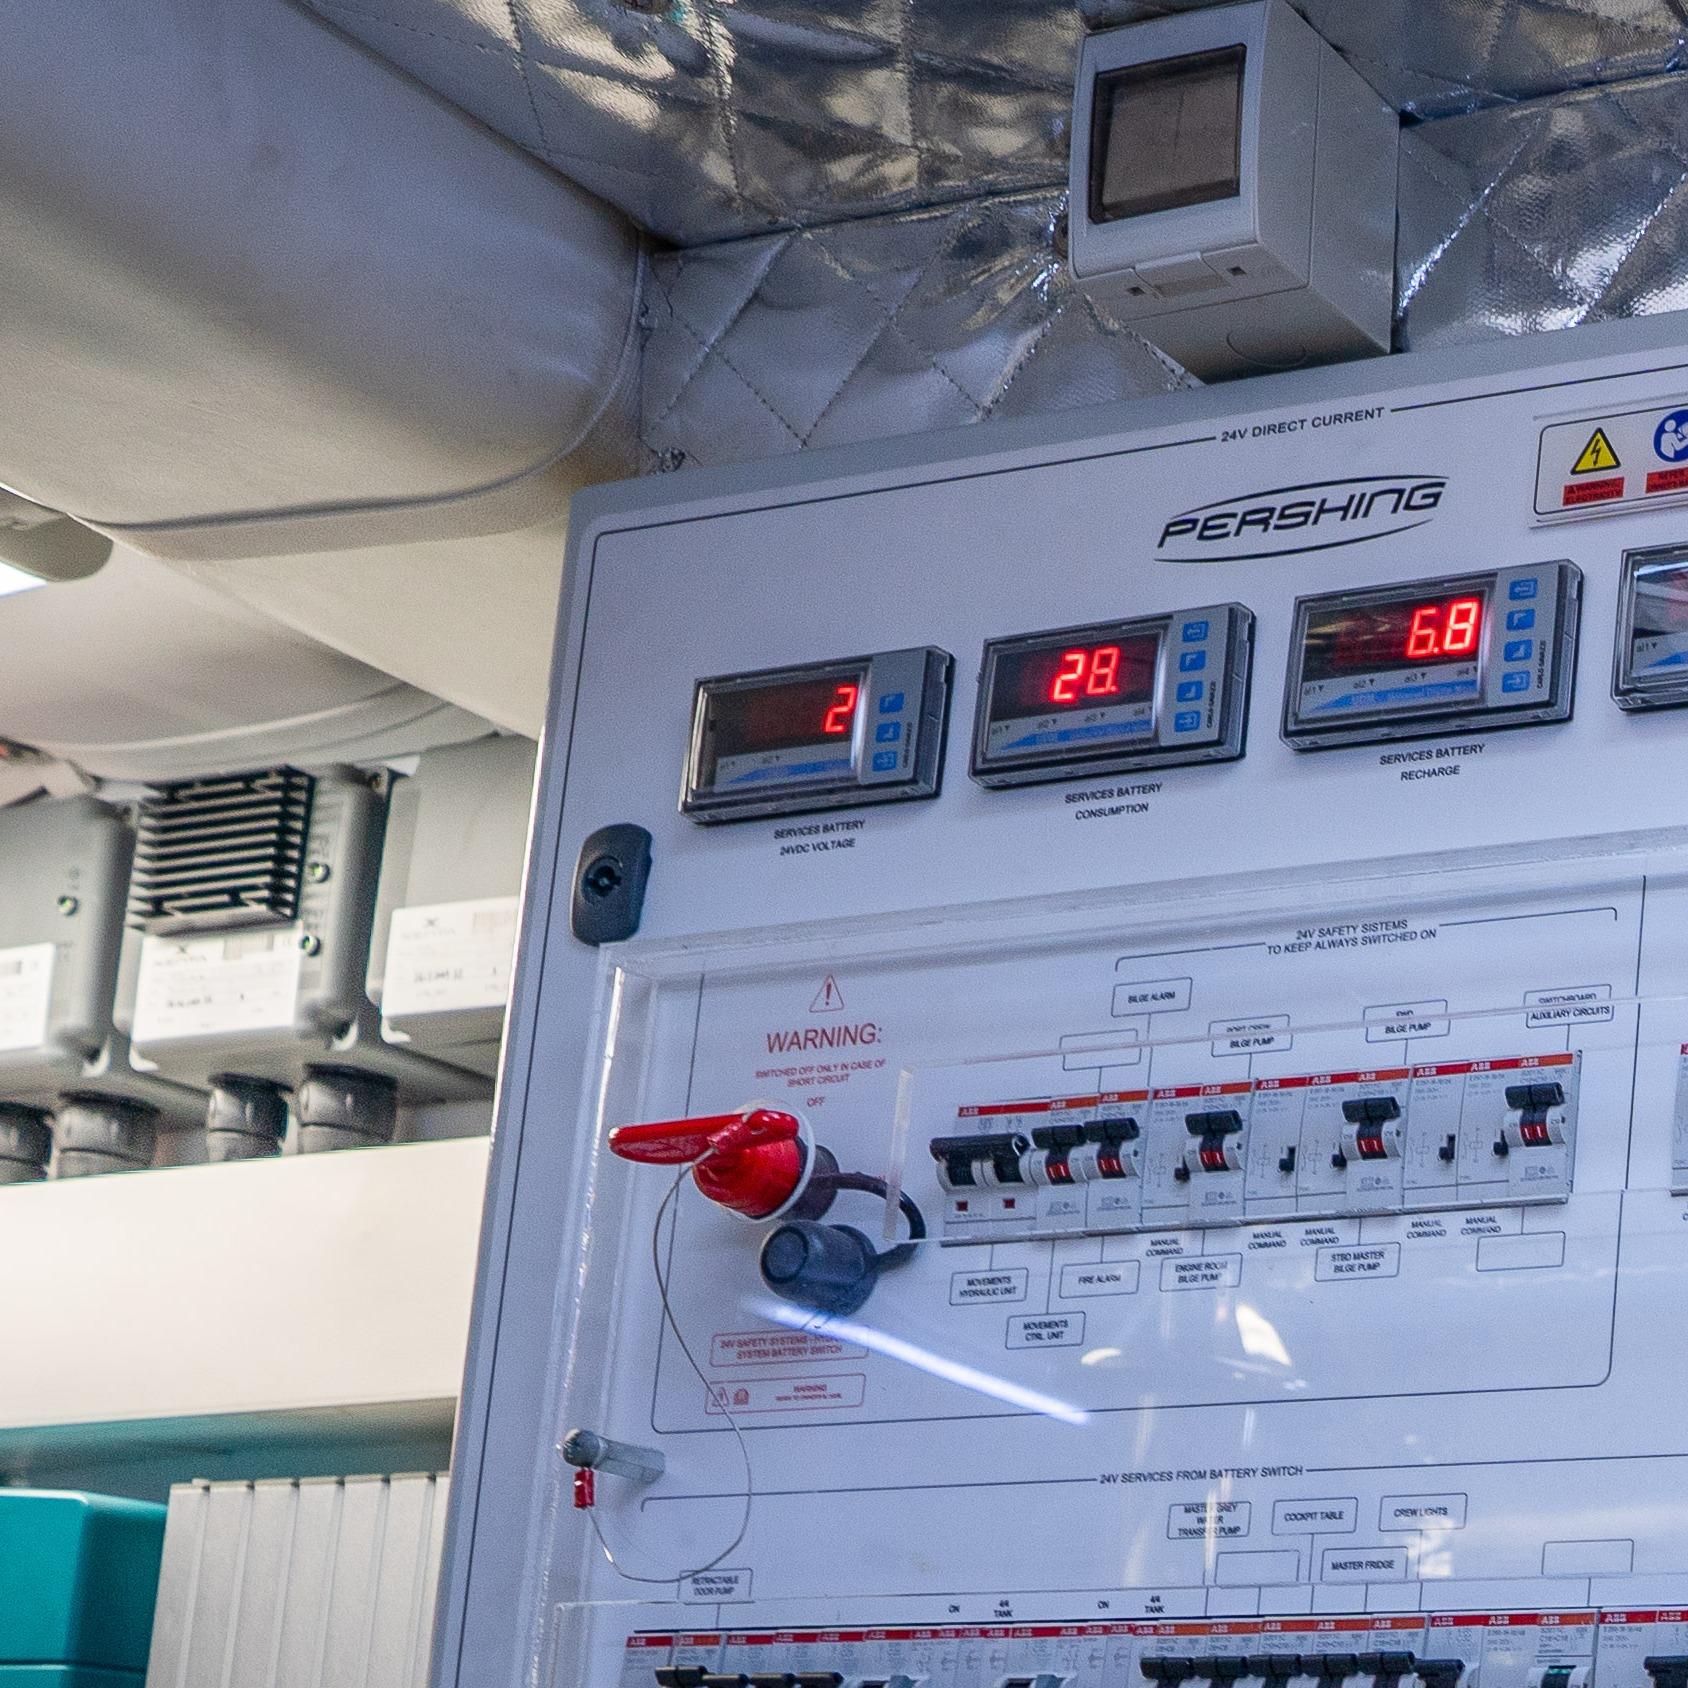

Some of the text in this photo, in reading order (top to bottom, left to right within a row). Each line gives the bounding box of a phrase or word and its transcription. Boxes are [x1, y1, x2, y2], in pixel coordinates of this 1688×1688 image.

[1221, 407, 1384, 442] 24V DIRECT CURRENT
[1158, 481, 1445, 549] PERSHING
[1380, 743, 1485, 765] SERVICES BATTERY
[1401, 765, 1460, 780] RECHARGE
[1065, 782, 1163, 804] SERVICES BATTERY
[1075, 803, 1149, 820] CONSUMPTION
[774, 818, 865, 839] SERVICES BATTERY
[812, 838, 855, 851] VOLTAGE
[1318, 925, 1358, 938] SAFETY
[1362, 919, 1407, 933] SISTEMS
[1284, 941, 1312, 953] KEEP
[1314, 937, 1358, 949] ALWAYS
[1361, 931, 1417, 946] SWITCHED
[1420, 929, 1436, 939] ON
[767, 1023, 882, 1053] WARNING:
[1365, 1560, 1394, 1569] FRIDGE
